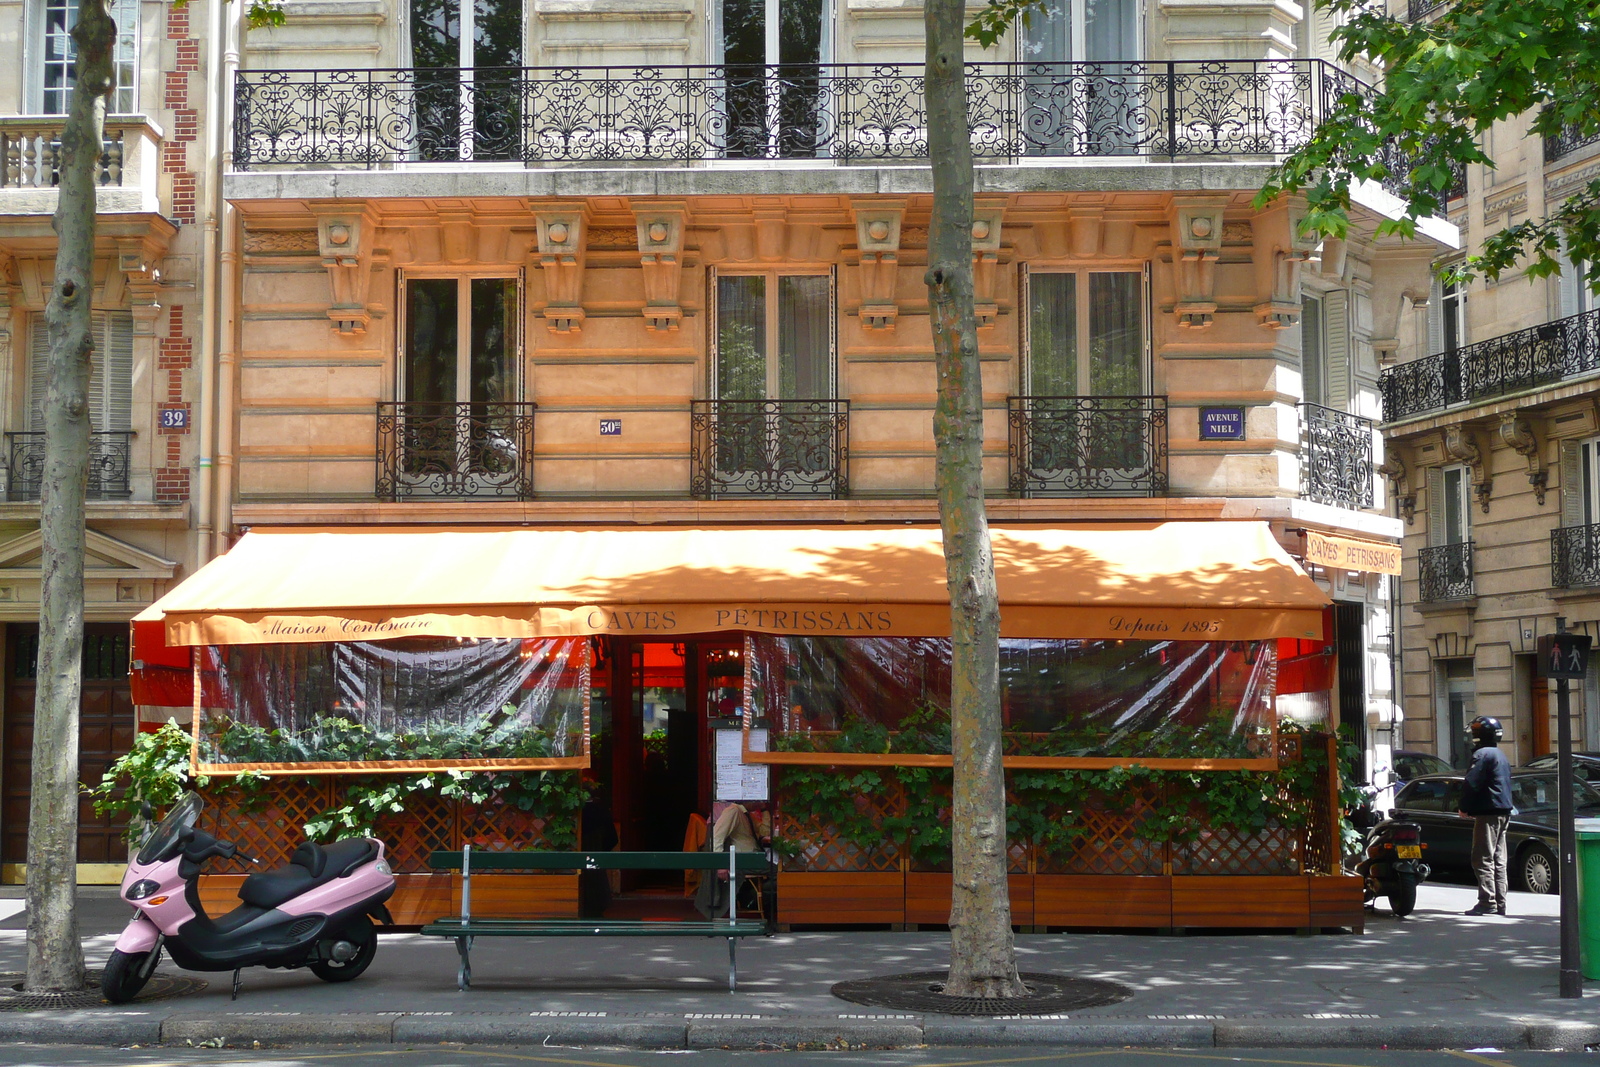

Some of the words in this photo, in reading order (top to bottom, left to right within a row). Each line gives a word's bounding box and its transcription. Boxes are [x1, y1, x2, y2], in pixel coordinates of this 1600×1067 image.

[164, 411, 183, 426] 32
[1206, 413, 1239, 422] AVENUE
[1210, 424, 1235, 433] NIEL
[1311, 539, 1338, 560] CAVES
[1346, 546, 1396, 569] PETRISSANS
[263, 620, 327, 635] Maison
[339, 618, 433, 633] Centenaire
[587, 611, 677, 630] CAVES
[716, 609, 892, 630] PETRISSANS
[1109, 615, 1170, 637] Depuis
[1181, 620, 1220, 633] 1895
